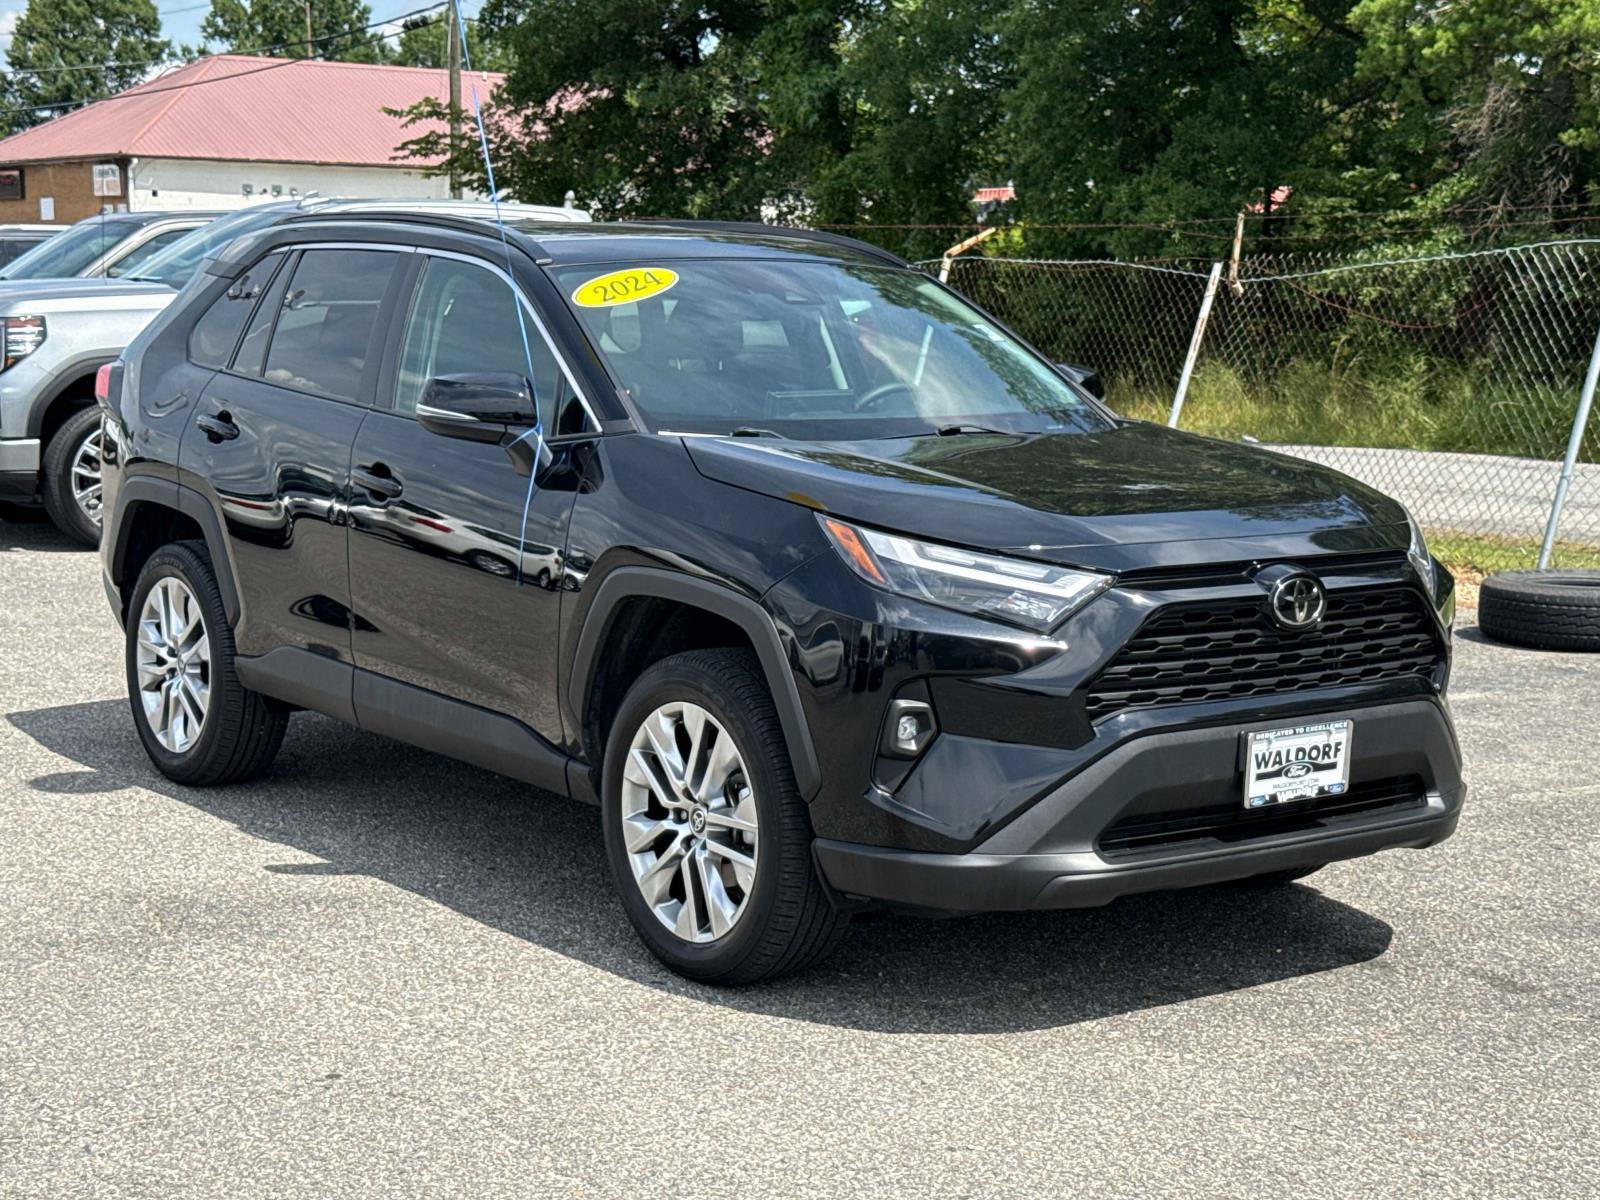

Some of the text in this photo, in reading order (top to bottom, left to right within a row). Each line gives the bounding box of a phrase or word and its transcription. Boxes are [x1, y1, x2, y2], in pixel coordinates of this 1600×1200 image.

[593, 271, 663, 302] 2024
[1255, 721, 1348, 740] DEDICATED TO EXCELLENCE
[1254, 741, 1343, 770] WALDORF
[1287, 765, 1308, 777] Ford
